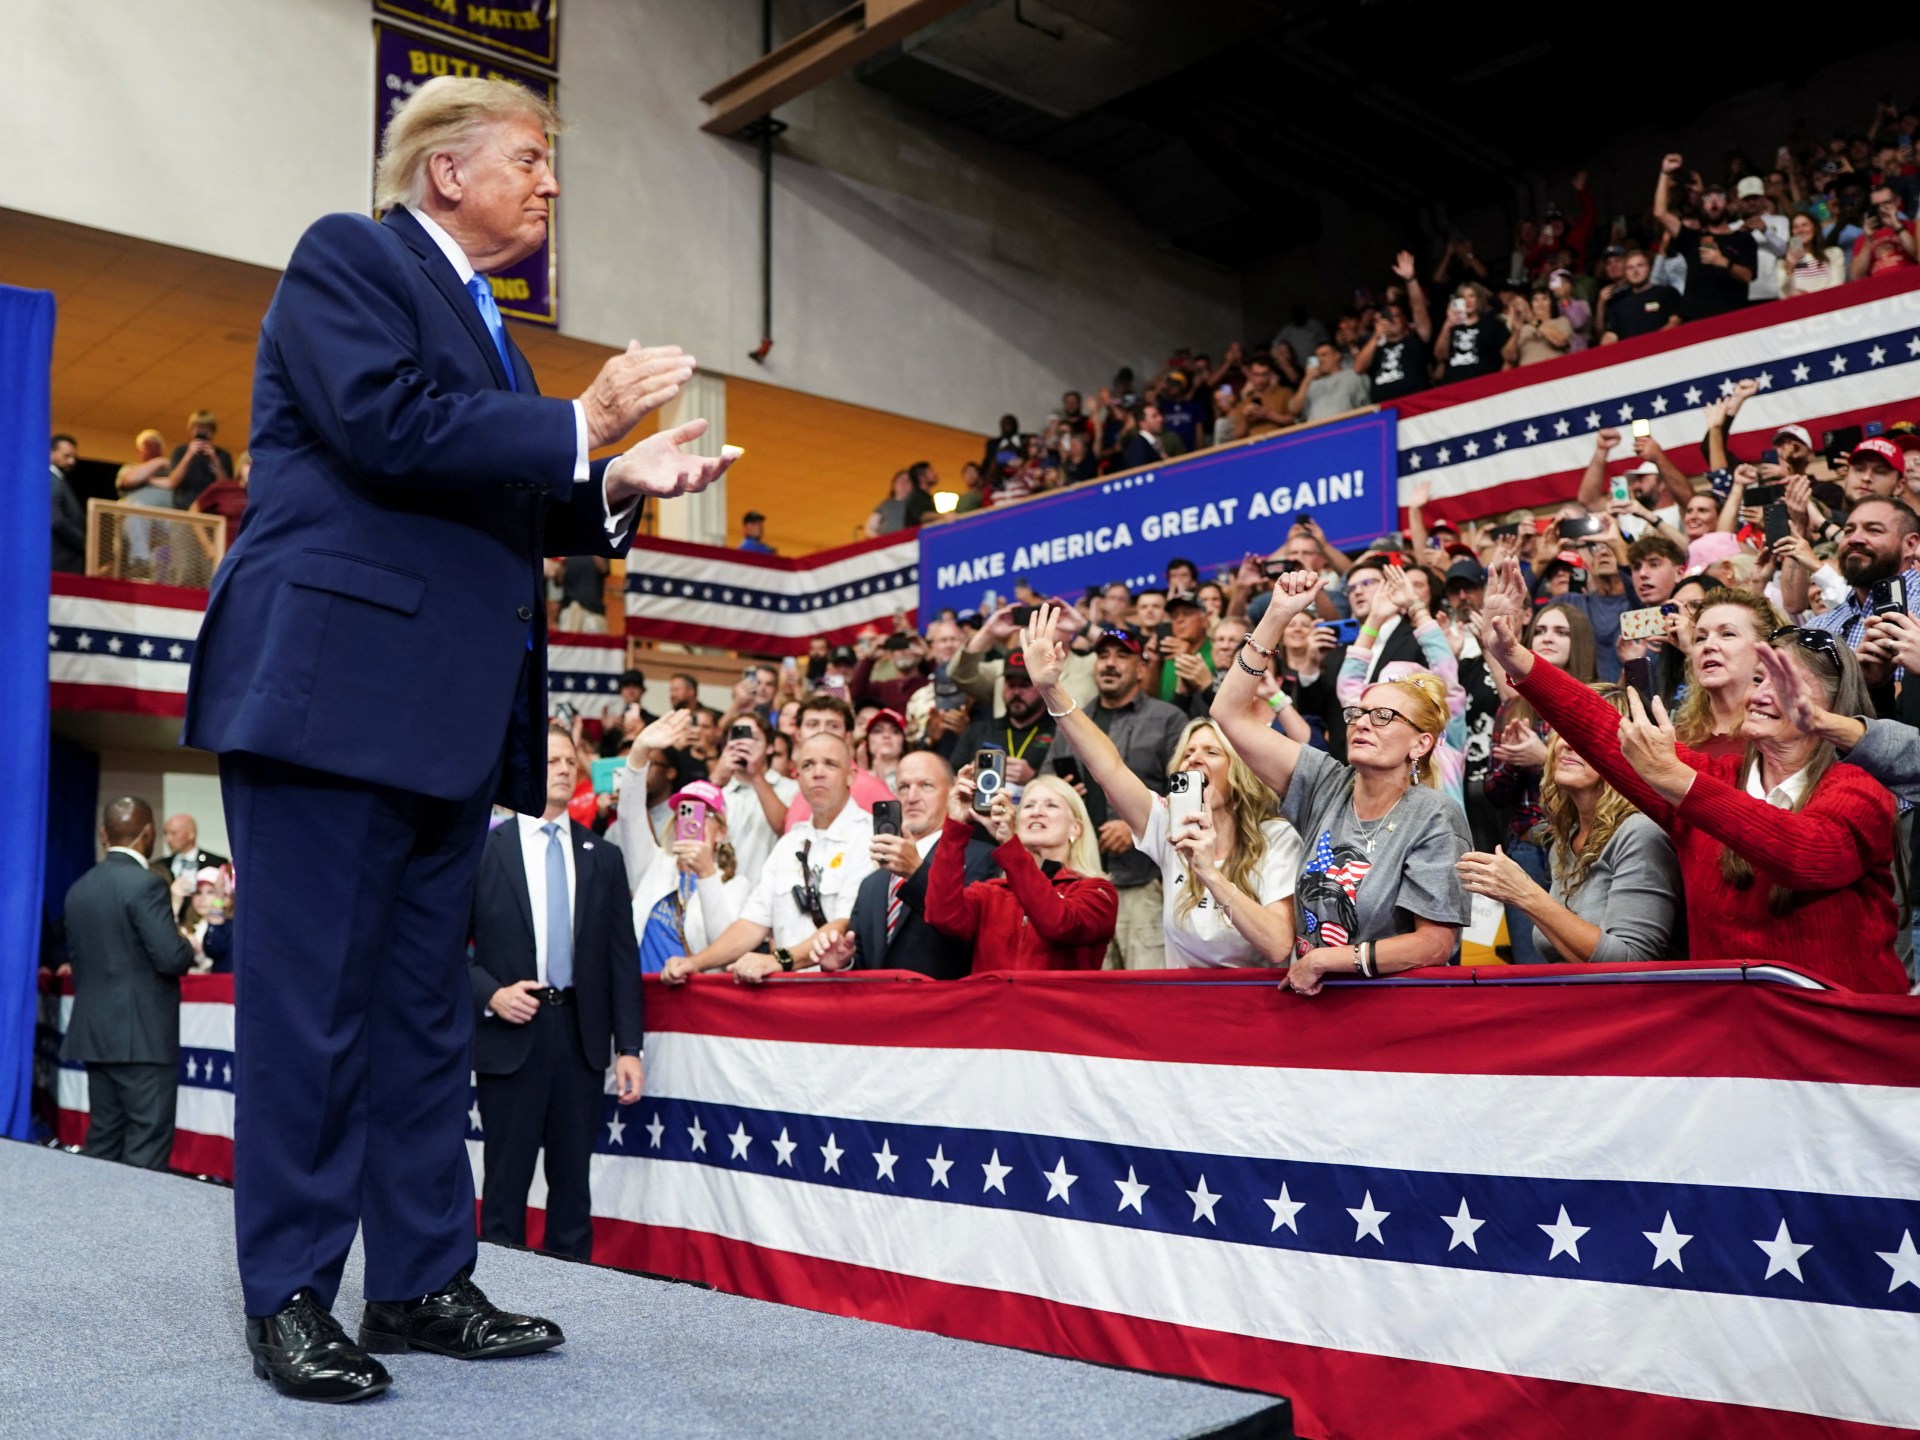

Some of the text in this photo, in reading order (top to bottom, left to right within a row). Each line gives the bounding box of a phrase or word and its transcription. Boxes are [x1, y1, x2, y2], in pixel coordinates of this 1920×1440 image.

[937, 470, 1364, 590] MAKE AMERICA GREAT AGAIN!
